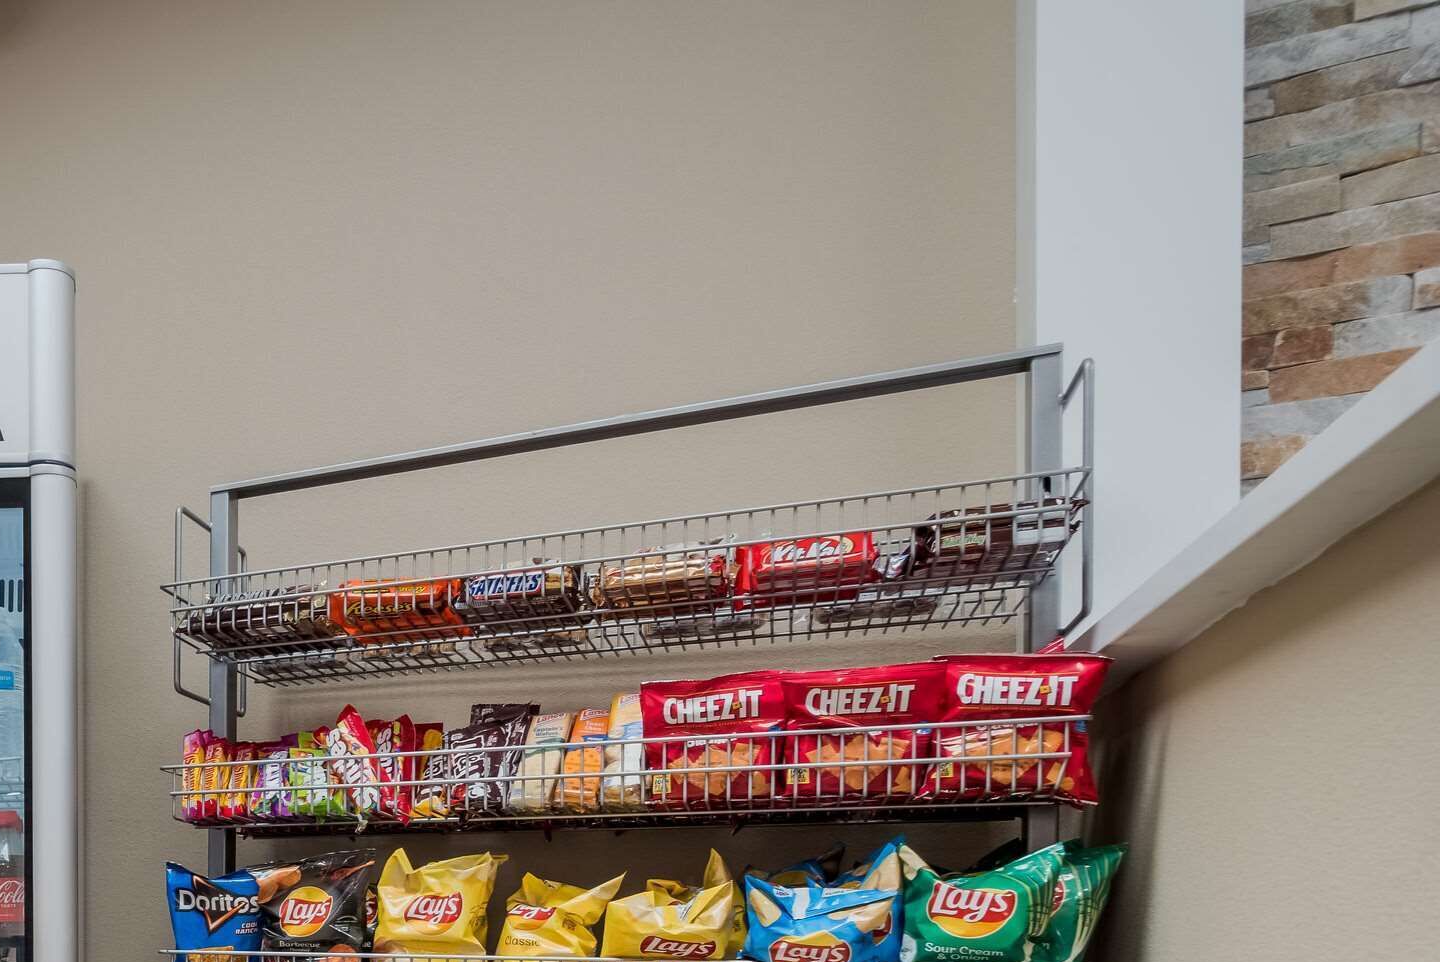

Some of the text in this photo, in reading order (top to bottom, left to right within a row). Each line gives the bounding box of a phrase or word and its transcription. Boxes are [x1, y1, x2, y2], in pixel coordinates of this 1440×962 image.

[805, 684, 916, 716] CHEEZ-IT
[957, 674, 1079, 706] CHEEZ-IT
[663, 689, 763, 725] CHEEZ-IT
[179, 889, 260, 914] Doritos
[284, 899, 330, 926] Lay's
[407, 895, 458, 925] Lay's
[931, 882, 1009, 922] Lay's
[924, 942, 1004, 957] Sour Cream
